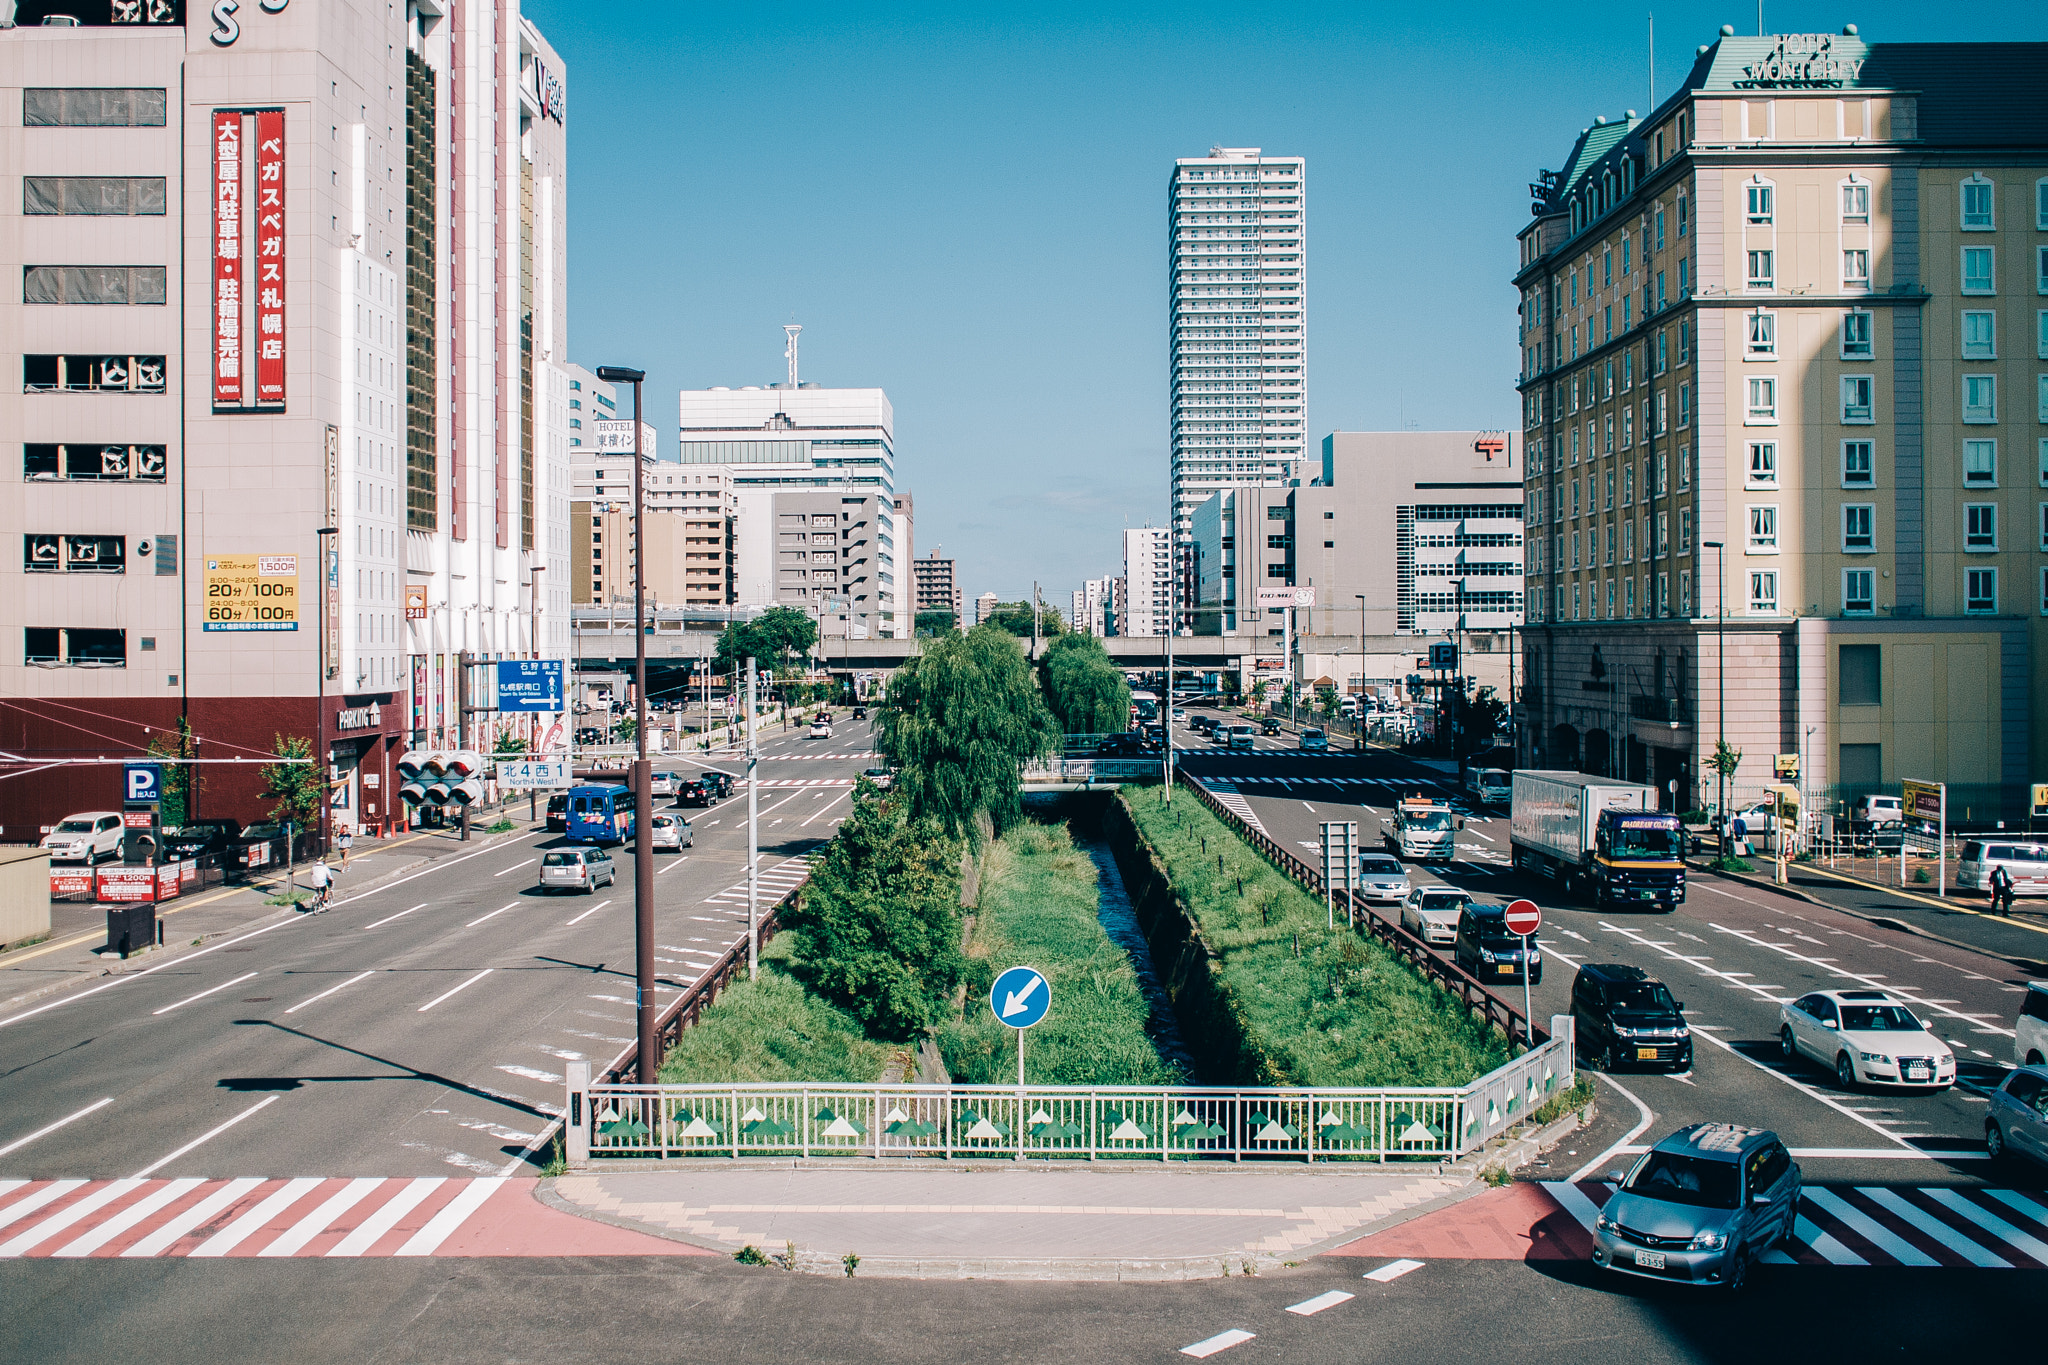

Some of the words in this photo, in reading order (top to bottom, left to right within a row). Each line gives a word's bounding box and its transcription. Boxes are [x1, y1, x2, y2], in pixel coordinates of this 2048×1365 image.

[1772, 33, 1841, 54] HOTEL
[1749, 59, 1865, 80] MONTEREY
[218, 121, 239, 378] 大型屋内駐車場・駐輪場完備
[261, 137, 282, 359] ベガスベガス札幌店
[599, 422, 634, 431] HOTEL
[260, 563, 295, 572] 1,500円
[500, 683, 540, 691] 札幌駅南口
[338, 708, 368, 729] PARKING
[129, 770, 154, 798] P
